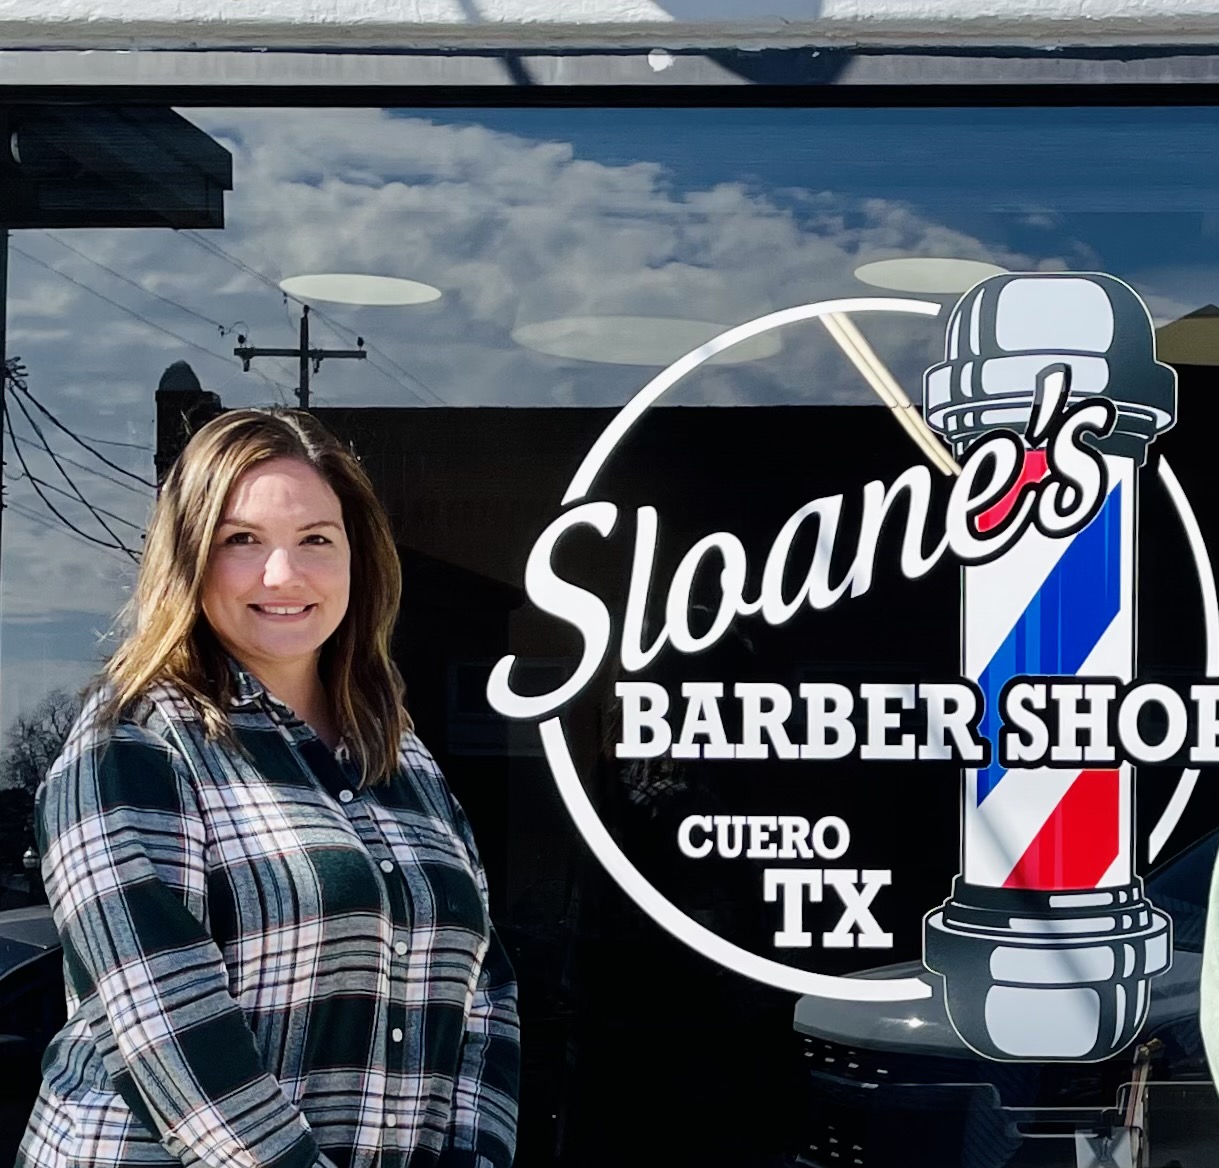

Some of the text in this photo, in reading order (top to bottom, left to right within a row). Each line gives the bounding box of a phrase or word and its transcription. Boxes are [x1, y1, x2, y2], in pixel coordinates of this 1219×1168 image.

[486, 365, 1111, 719] Sloane's
[614, 681, 985, 761] BARBER
[677, 814, 852, 860] CUERO
[763, 868, 895, 949] TX
